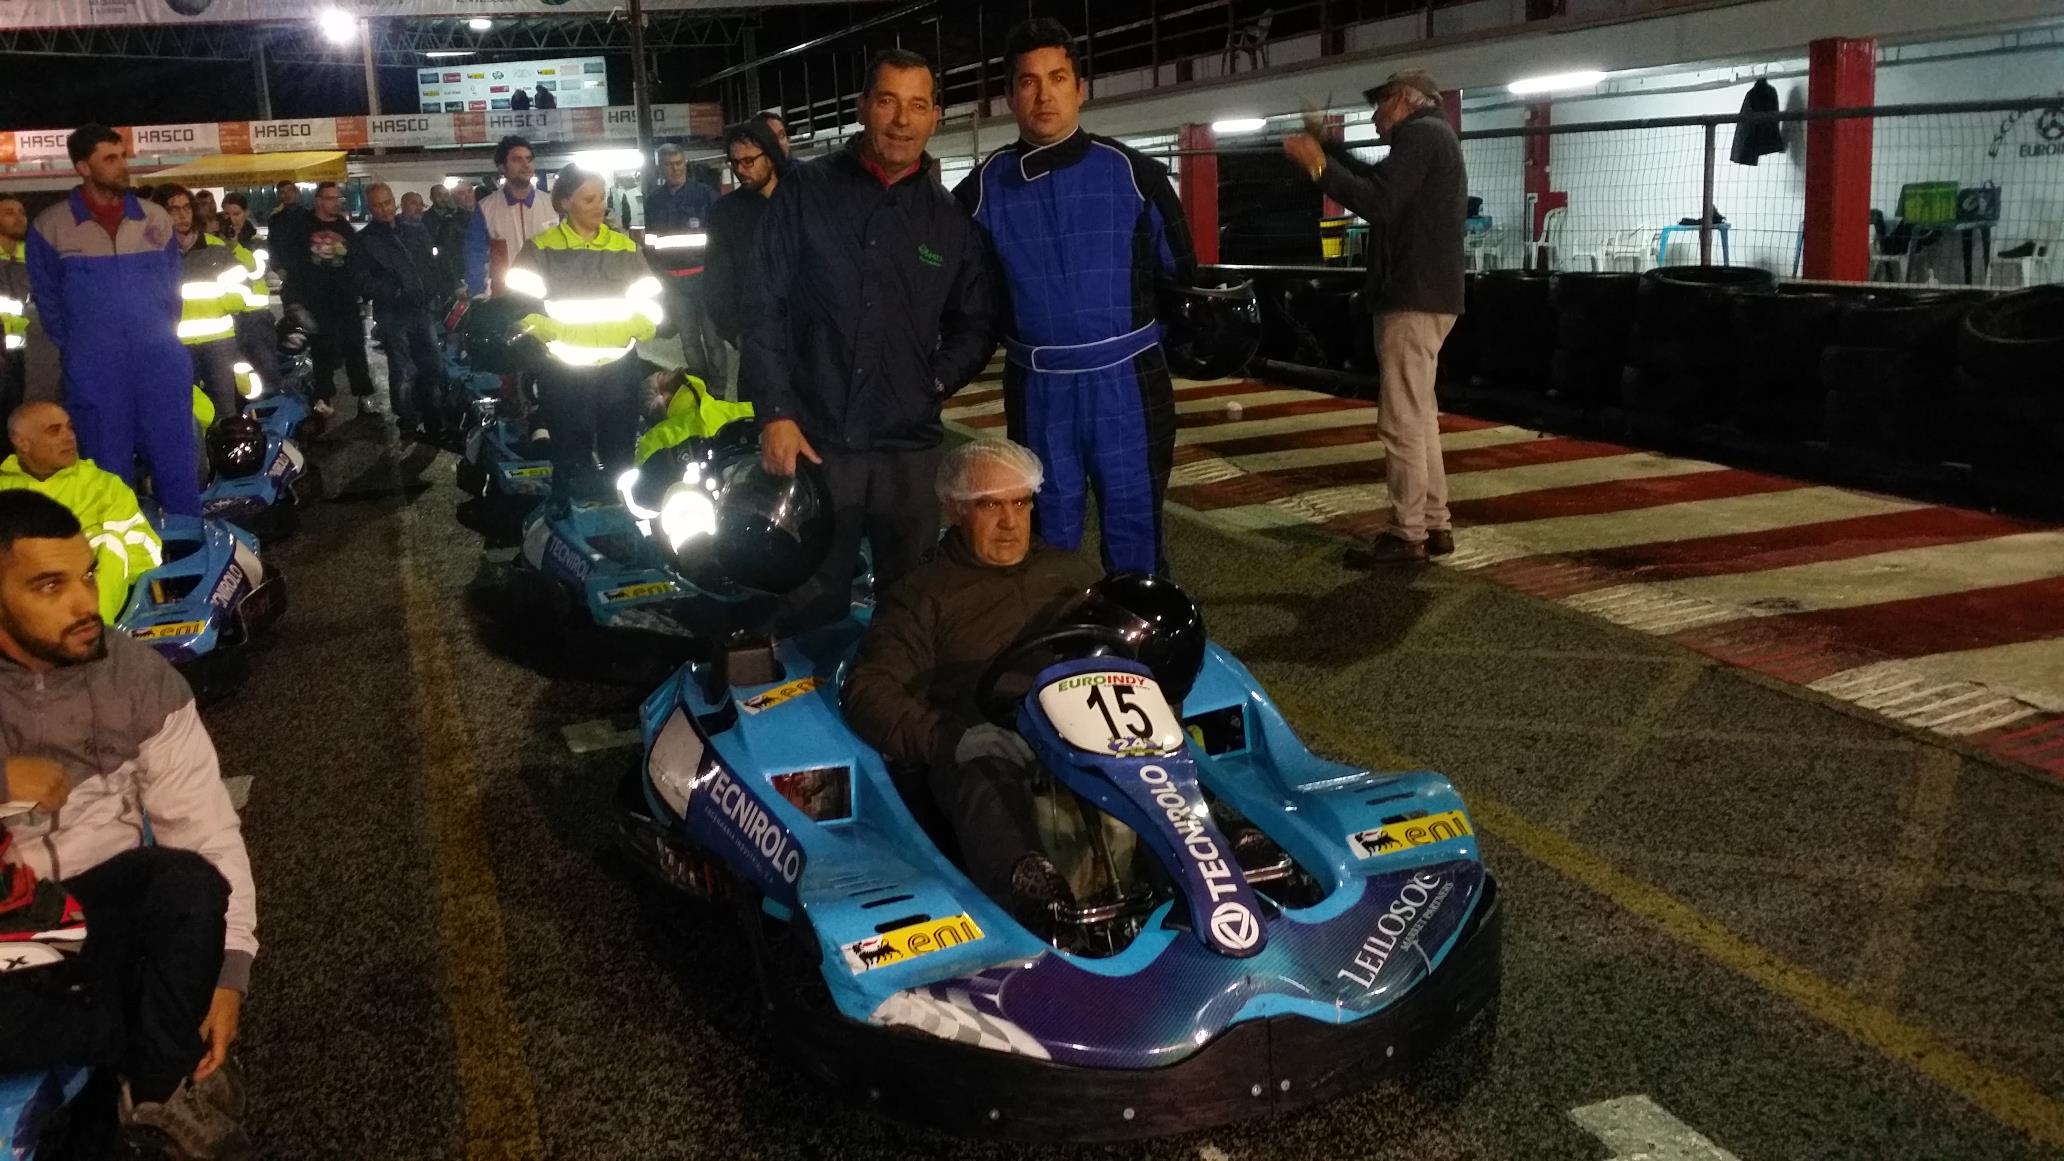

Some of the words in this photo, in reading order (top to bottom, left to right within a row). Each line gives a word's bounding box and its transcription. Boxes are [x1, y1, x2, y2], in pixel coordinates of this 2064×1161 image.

[490, 113, 547, 128] HASCO
[608, 108, 665, 124] HAO
[254, 123, 311, 138] HASCO
[372, 118, 429, 133] HASCO
[21, 134, 68, 149] HASC
[138, 128, 194, 144] HASCO
[160, 620, 200, 636] eni
[1058, 674, 1146, 693] EUROINDY
[1086, 684, 1154, 740] 15
[702, 760, 800, 884] TECNIROLO
[1404, 811, 1469, 847] eni
[1139, 764, 1238, 903] TECNIROLO
[906, 914, 977, 956] eni
[1337, 870, 1441, 990] LEILOSOC
